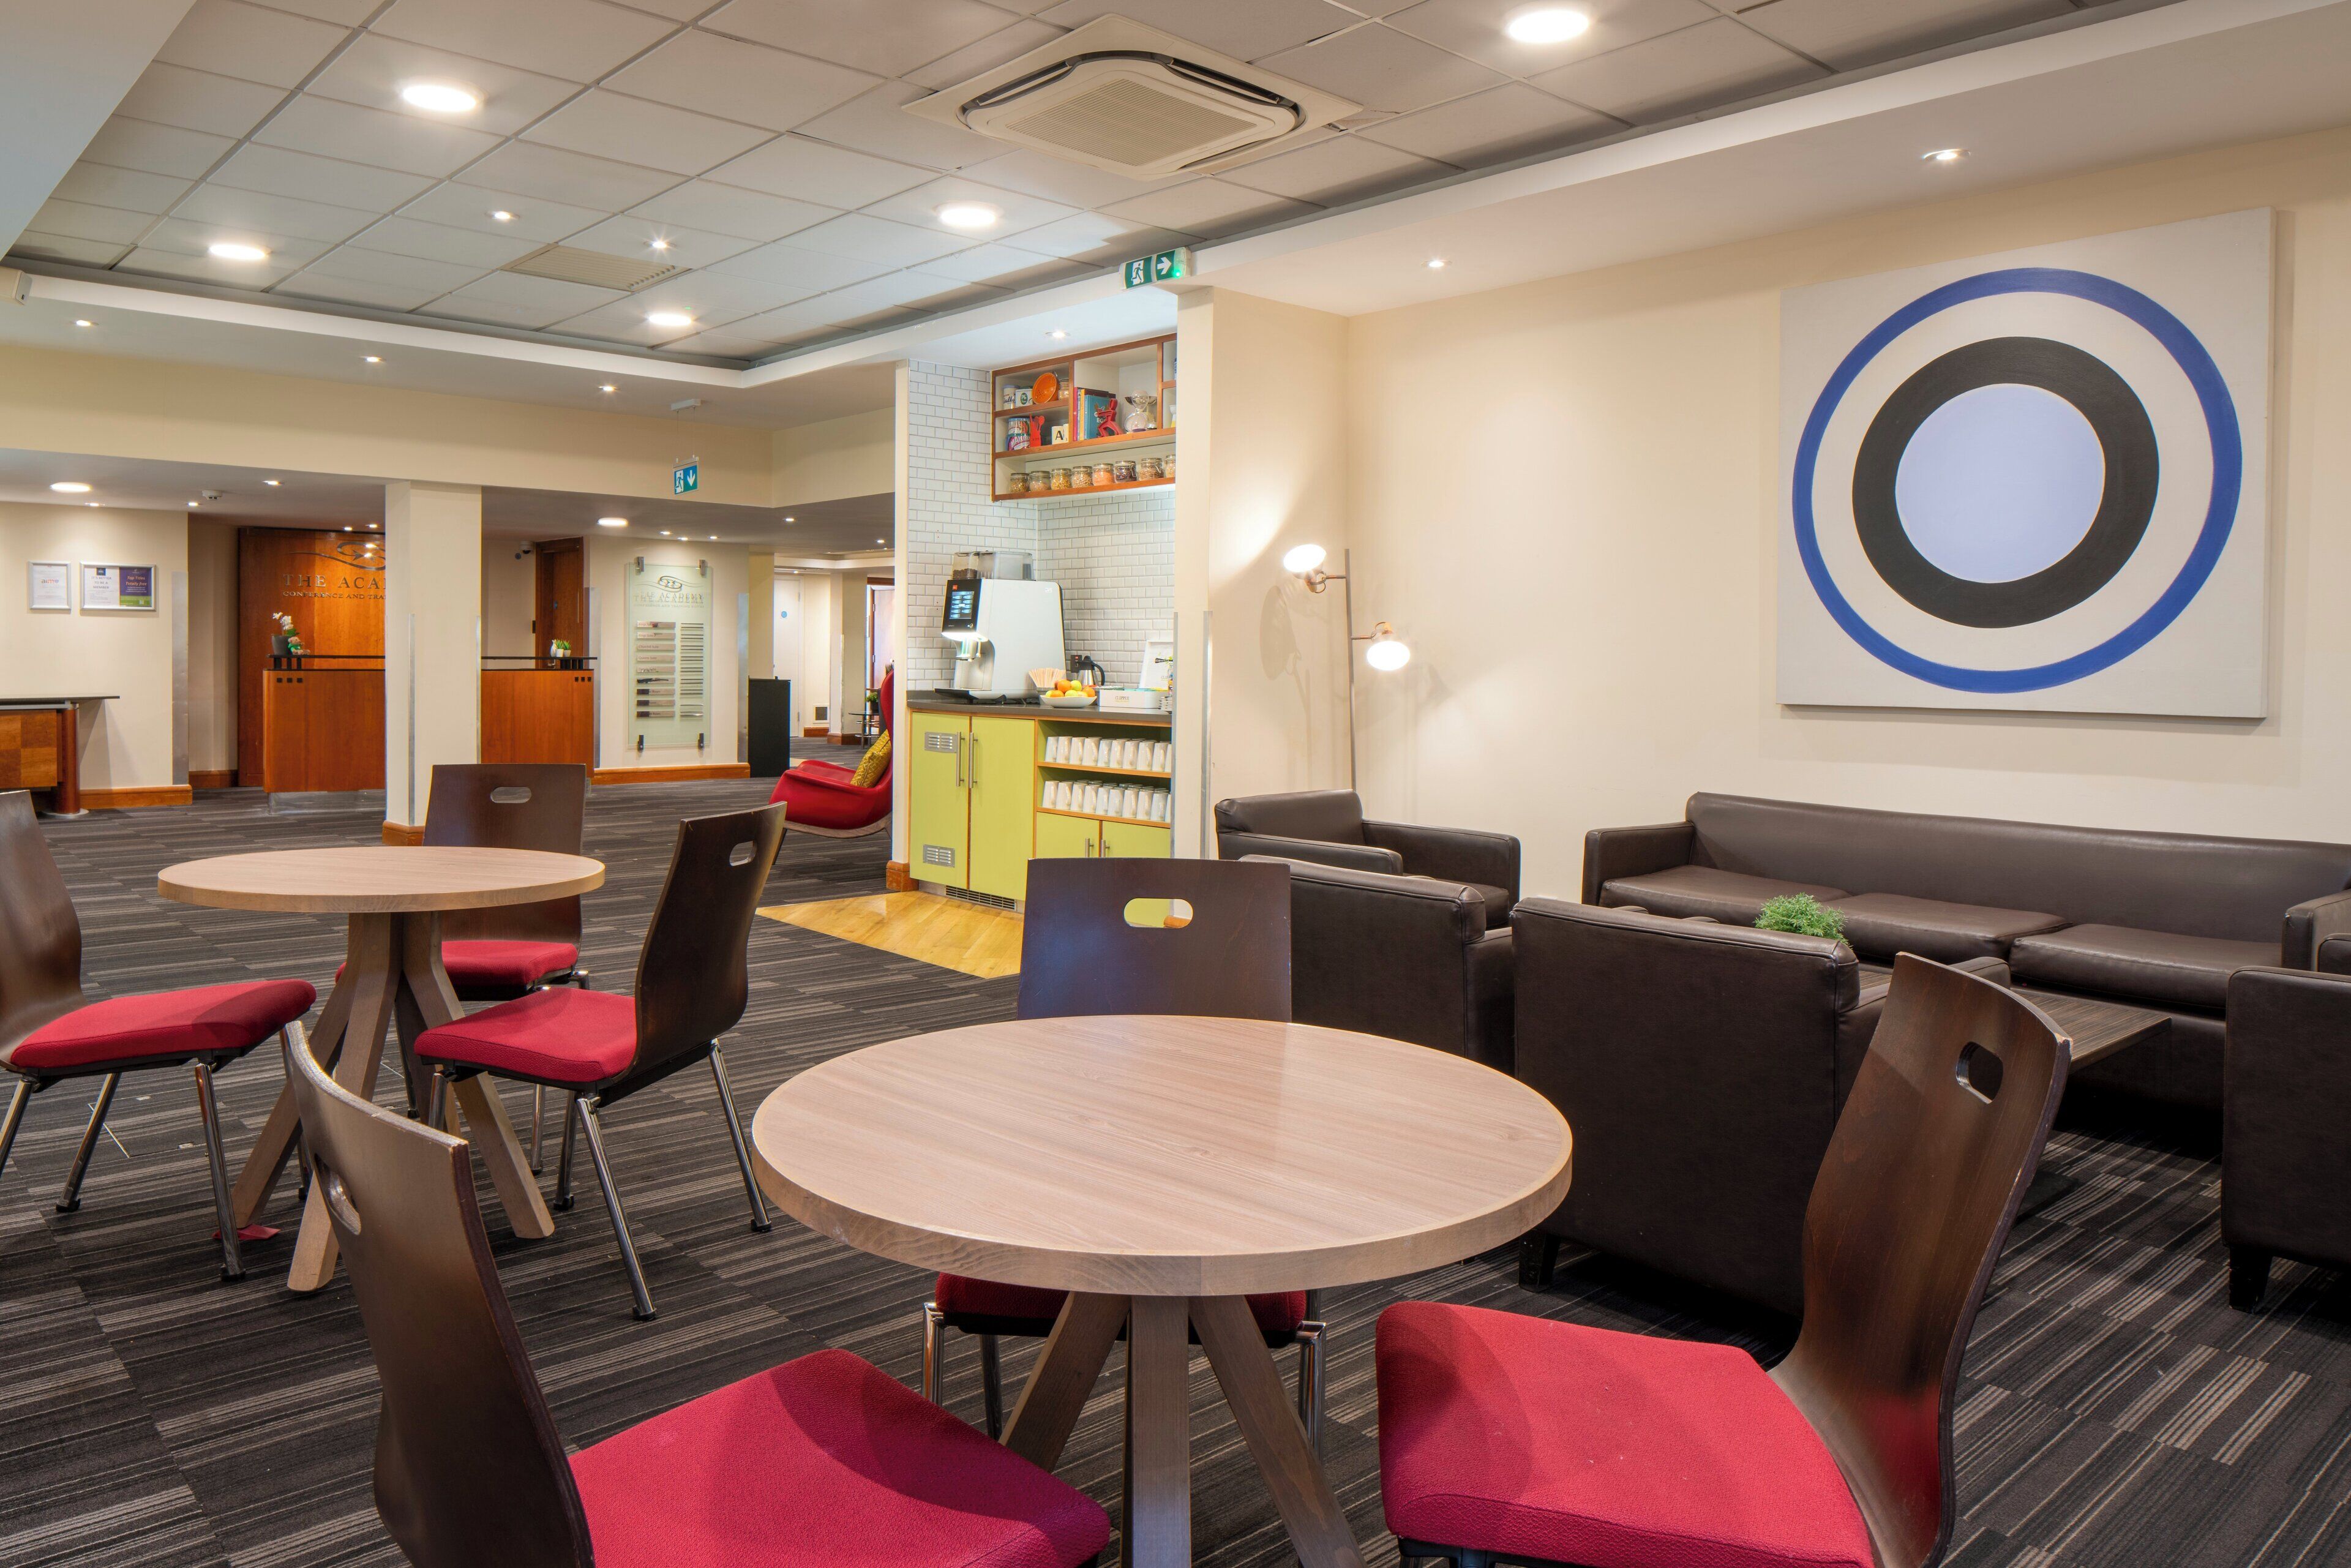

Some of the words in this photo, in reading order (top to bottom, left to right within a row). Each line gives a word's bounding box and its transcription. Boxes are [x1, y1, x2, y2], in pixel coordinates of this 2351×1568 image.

[1056, 430, 1063, 440] A
[283, 574, 326, 587] THE
[338, 577, 386, 590] ACA
[659, 592, 704, 603] ACADEMY
